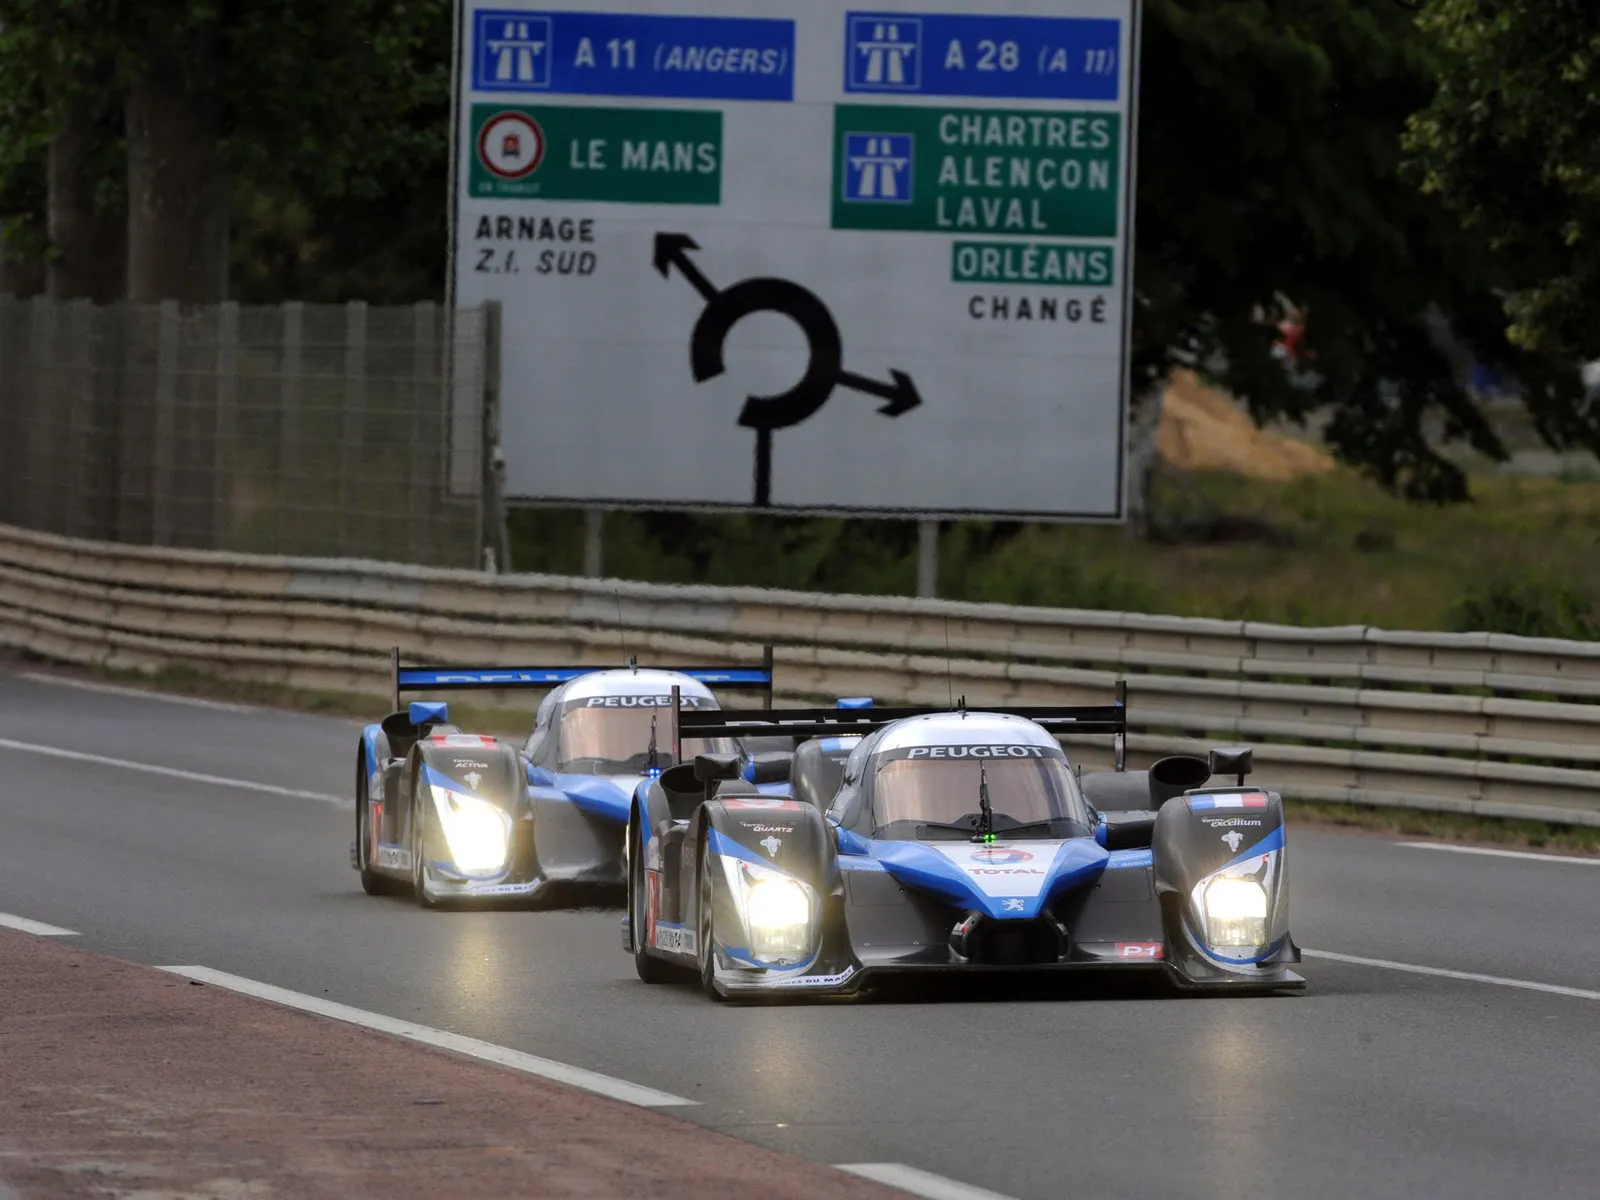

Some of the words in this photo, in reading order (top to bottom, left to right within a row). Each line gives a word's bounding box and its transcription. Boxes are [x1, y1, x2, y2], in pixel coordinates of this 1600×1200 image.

[574, 37, 595, 68] A
[606, 38, 636, 69] 11
[653, 42, 788, 75] (ANGERS)
[944, 38, 965, 69] A
[976, 40, 1019, 71] 28
[938, 114, 1110, 148] CHARTRES
[569, 138, 607, 170] LE
[622, 140, 717, 173] MANS
[937, 155, 1109, 192] ALENÇON
[474, 215, 595, 242] ARNAGE
[936, 196, 1048, 229] LAVAL
[474, 249, 519, 274] Z.I.
[535, 249, 597, 275] SUD
[956, 242, 1107, 282] ORLÉANS
[968, 293, 1107, 323] CHANGÉ
[907, 745, 1043, 759] PEUGEOT
[1123, 946, 1156, 957] P1
